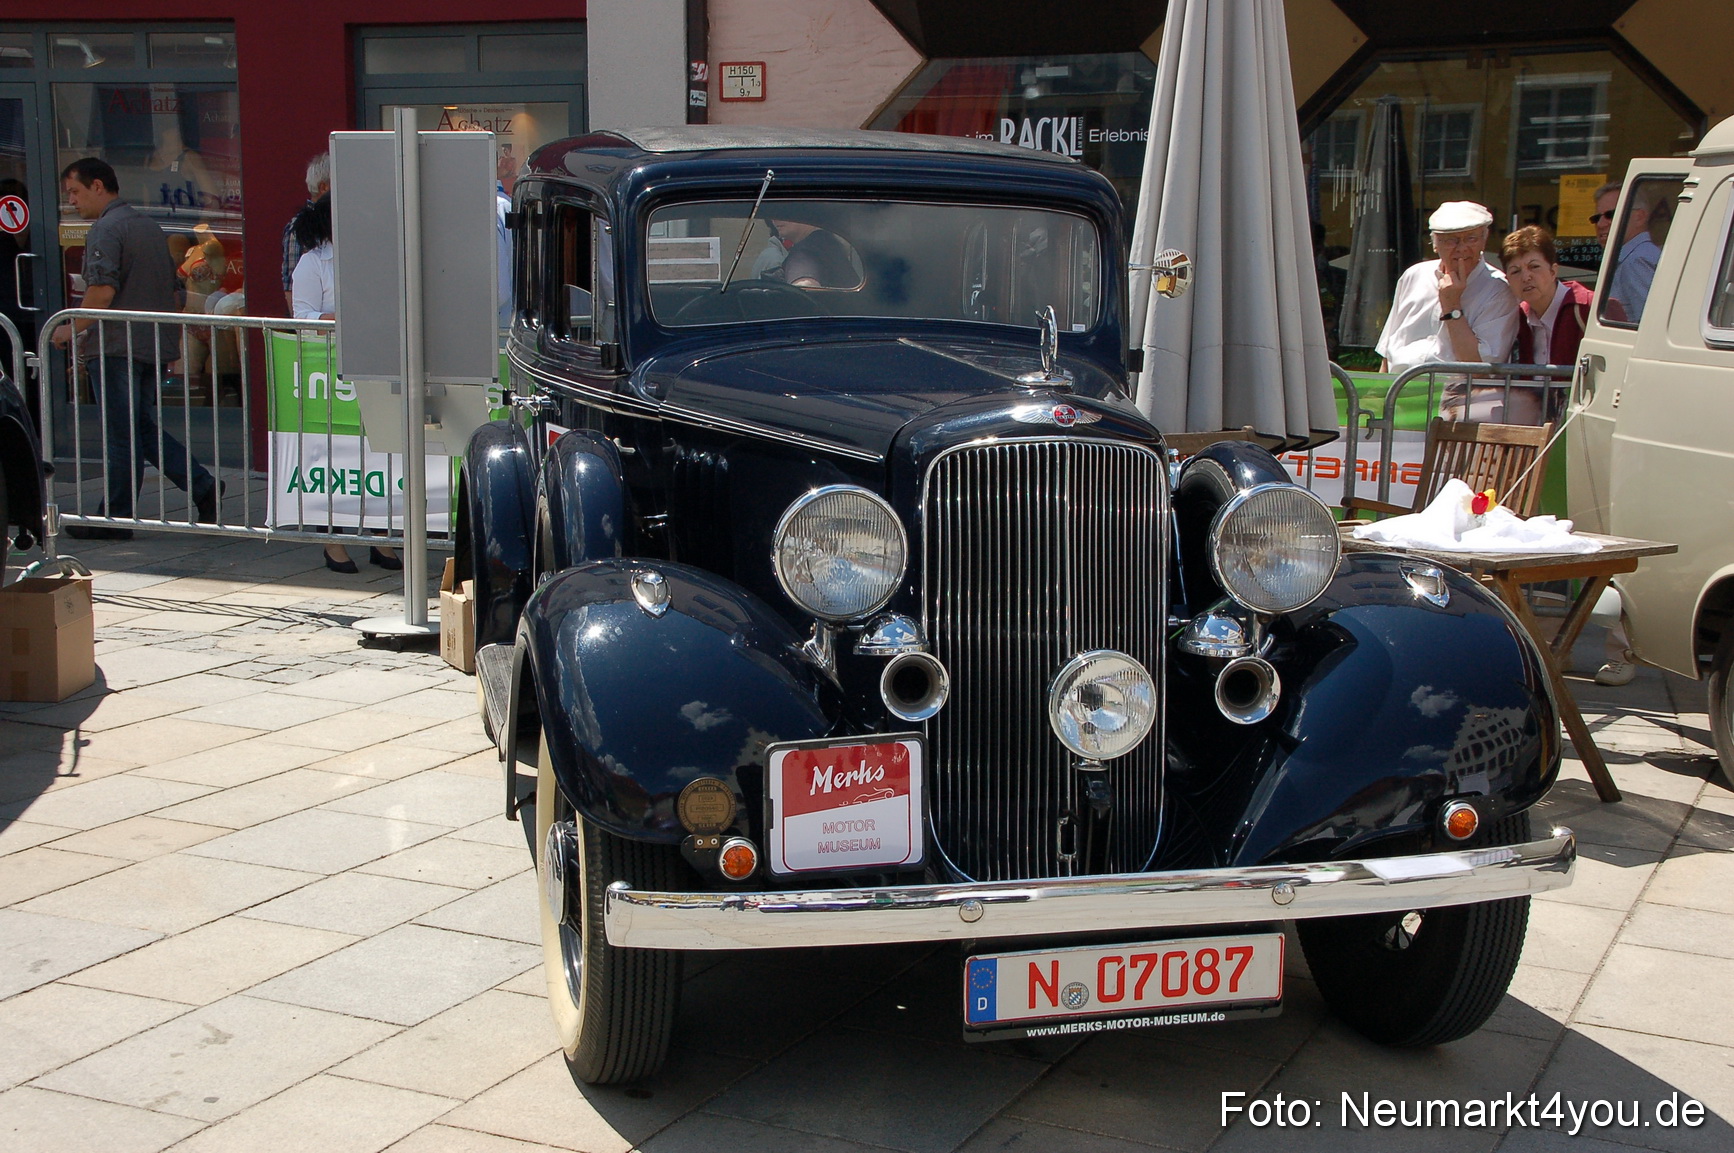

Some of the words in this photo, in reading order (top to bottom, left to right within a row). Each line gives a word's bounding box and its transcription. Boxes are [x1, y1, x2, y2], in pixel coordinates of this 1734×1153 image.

[437, 109, 513, 133] Achatz
[809, 759, 885, 796] Merks
[822, 818, 876, 835] MOTOR
[817, 837, 881, 854] MUSEUM
[1028, 960, 1060, 1009] N
[1096, 946, 1254, 1004] 07087
[977, 997, 988, 1011] D
[1026, 1012, 1226, 1037] www.MERKS-MOTOR-MUSEUM.de
